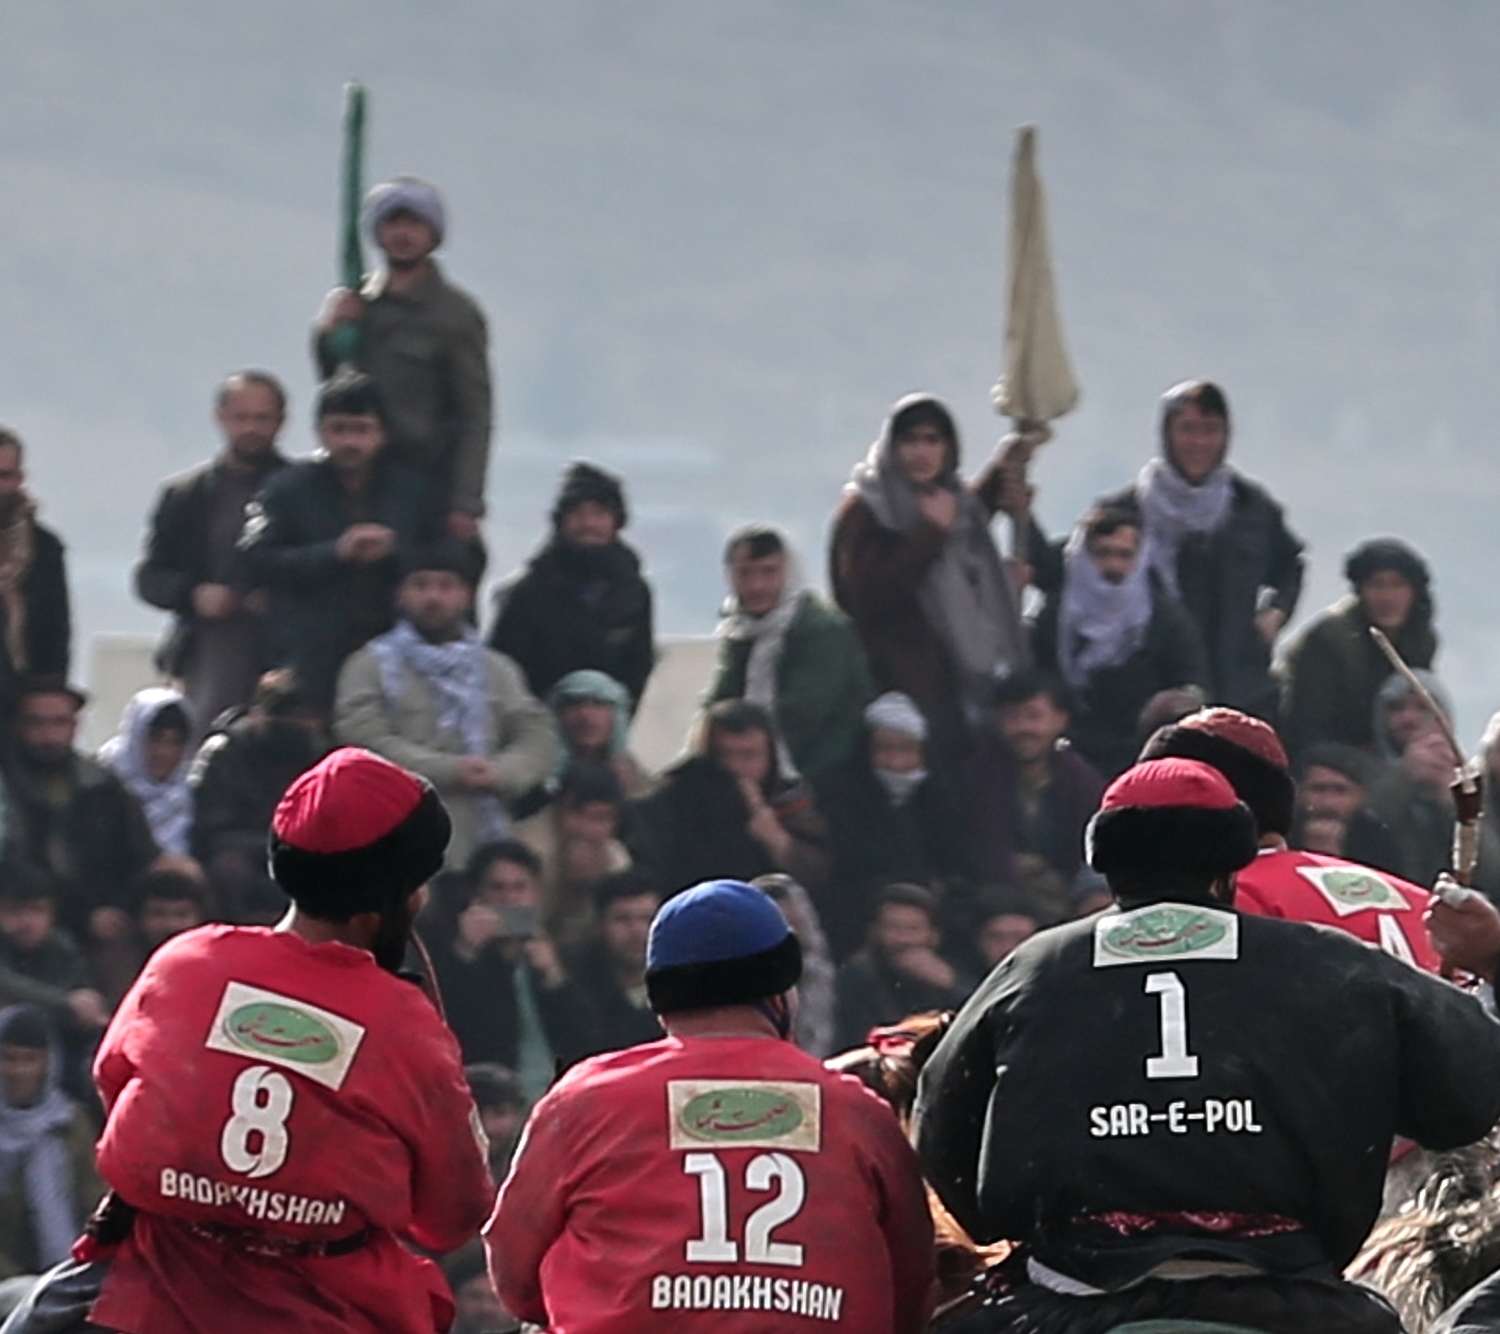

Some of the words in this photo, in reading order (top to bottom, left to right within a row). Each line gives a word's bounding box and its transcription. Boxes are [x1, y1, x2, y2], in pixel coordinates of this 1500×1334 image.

[1145, 971, 1198, 1078] 1
[221, 1066, 293, 1178] 8
[1090, 1099, 1262, 1137] SAR-E-POL
[684, 1153, 804, 1266] 12
[652, 1275, 843, 1321] BADAKHSHAN
